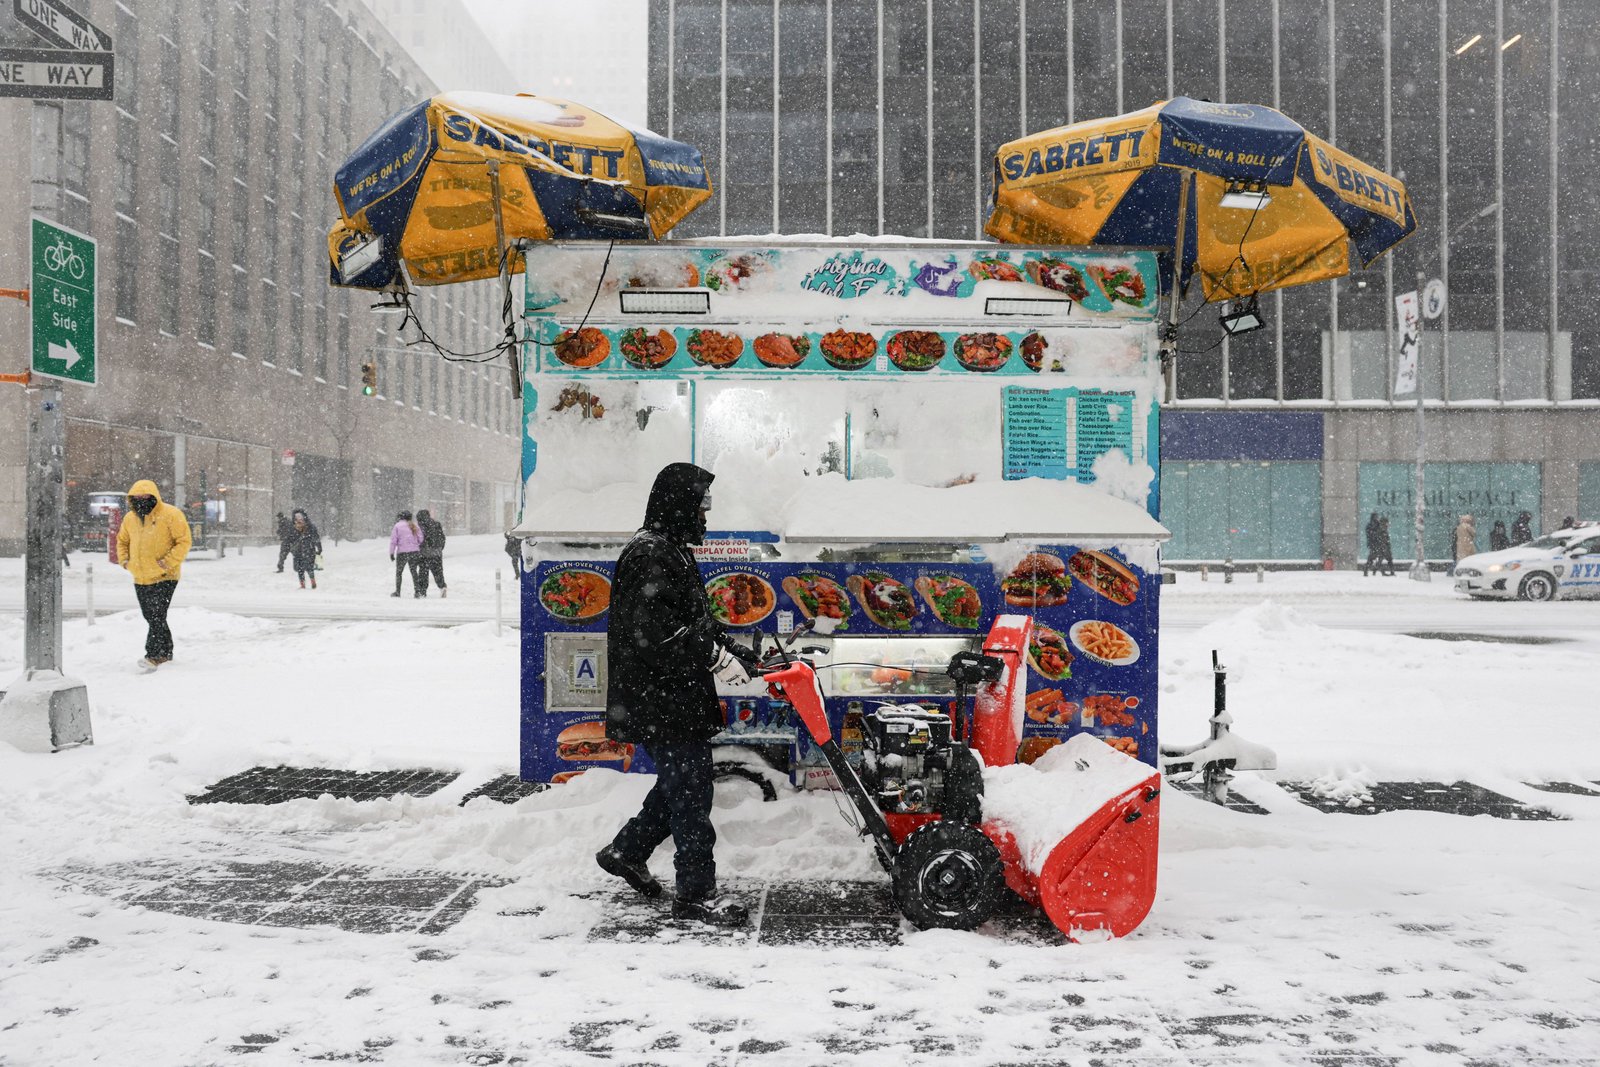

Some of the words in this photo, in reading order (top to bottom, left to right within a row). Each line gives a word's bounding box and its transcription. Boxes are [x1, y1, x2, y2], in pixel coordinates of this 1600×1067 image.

[29, 0, 59, 32] ONE
[0, 64, 25, 83] NE
[48, 65, 94, 85] WAY
[1004, 129, 1146, 181] SABRETT
[1172, 137, 1206, 155] WE'RE
[1207, 147, 1224, 160] ON
[1225, 151, 1234, 162] A
[1237, 153, 1266, 166] ROLL
[381, 163, 393, 179] ON
[395, 158, 402, 169] A
[1123, 159, 1141, 169] 2019
[1316, 148, 1403, 213] SBRETT
[811, 257, 888, 282] riginal
[53, 287, 79, 308] East
[52, 311, 77, 331] Side
[690, 547, 724, 555] DISPLAY
[727, 547, 749, 555] ONLY
[543, 562, 573, 576] CHICKEN
[594, 565, 611, 577] RICE
[704, 565, 732, 579] FALAFEL
[821, 570, 836, 579] GYRO
[577, 659, 595, 678] A
